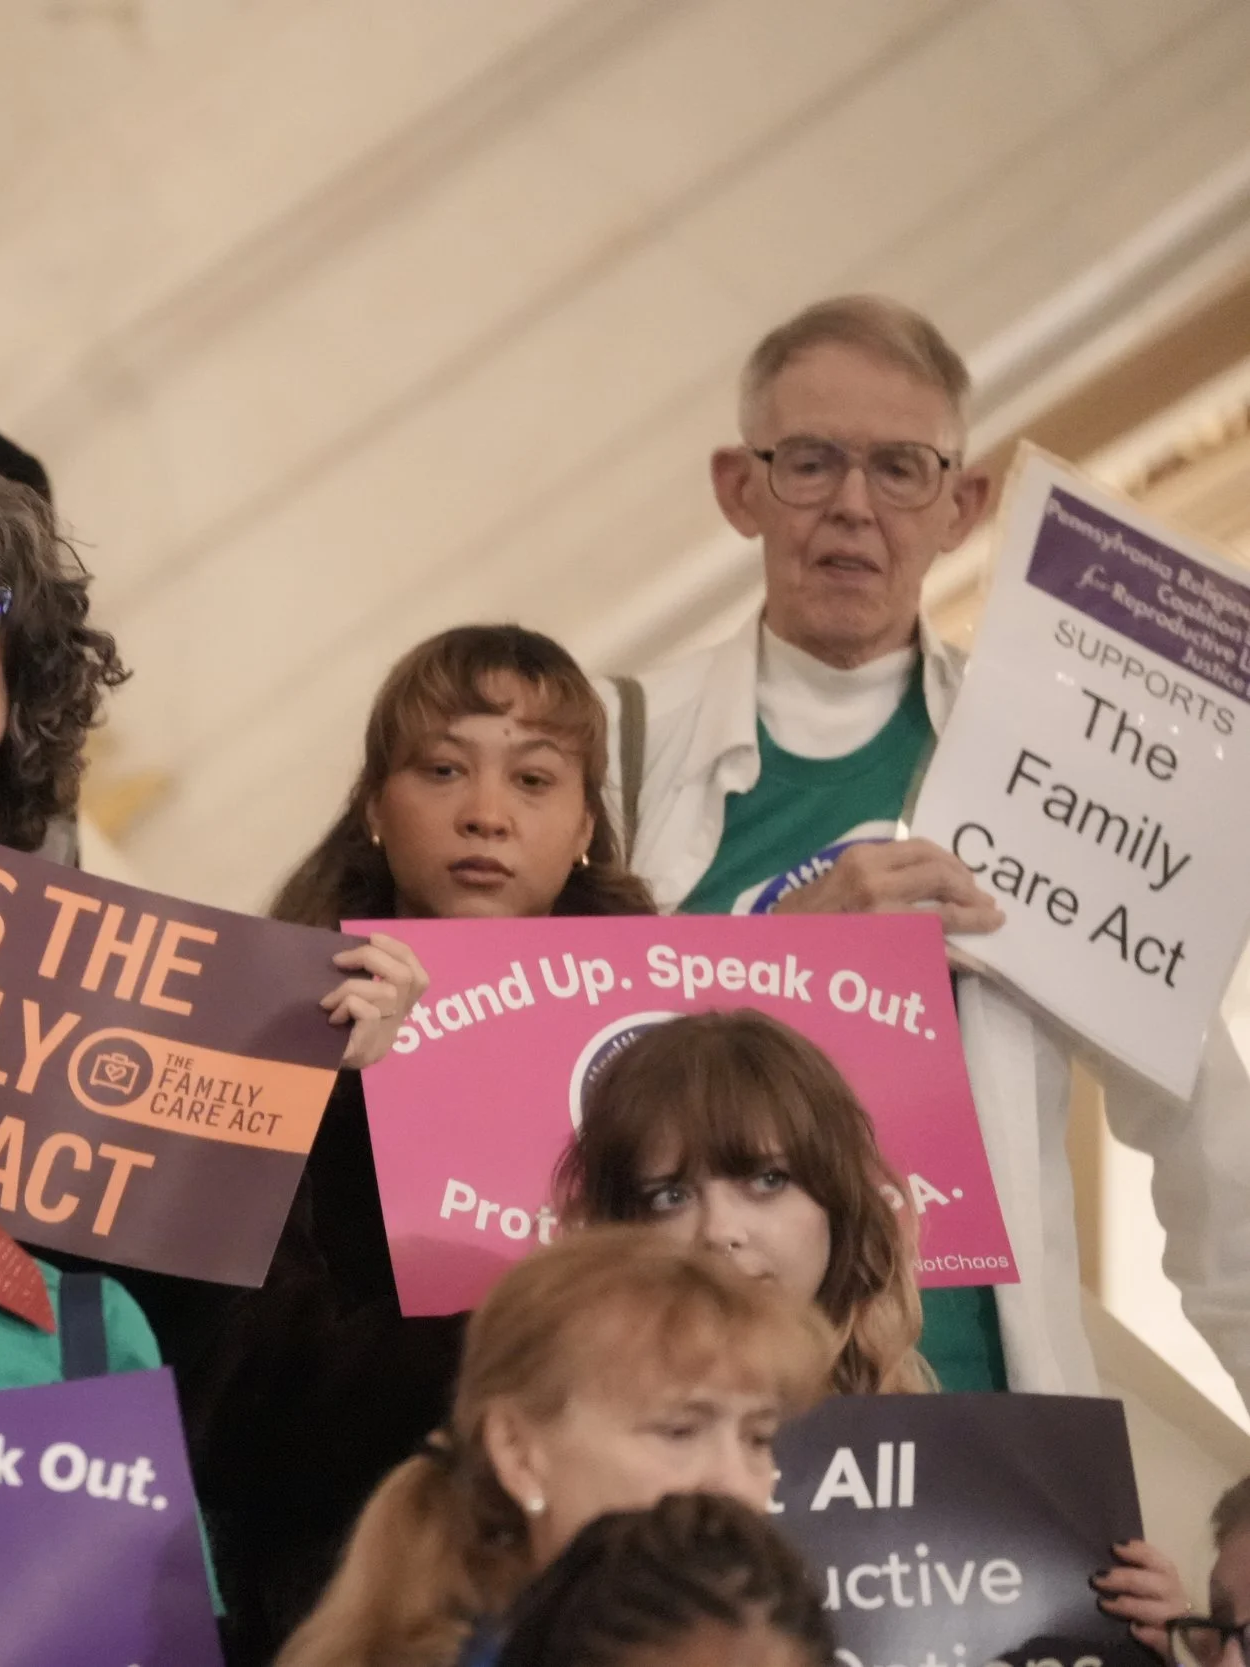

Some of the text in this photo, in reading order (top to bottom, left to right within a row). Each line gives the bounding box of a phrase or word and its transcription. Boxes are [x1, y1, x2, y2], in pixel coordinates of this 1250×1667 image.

[1054, 618, 1236, 737] SUPPORTS
[1081, 687, 1178, 782] The
[1005, 749, 1191, 893] Family
[951, 822, 1186, 990] Care Act
[37, 885, 219, 1016] THE
[540, 952, 634, 1006] Up.
[647, 944, 814, 1003] Speak
[827, 969, 938, 1041] Out.
[158, 1068, 264, 1108] FAMILY
[166, 1053, 195, 1070] THE
[150, 1092, 283, 1136] CARE ACT
[438, 1178, 558, 1248] Prot
[39, 1441, 168, 1511] Out.
[810, 1441, 916, 1511] All
